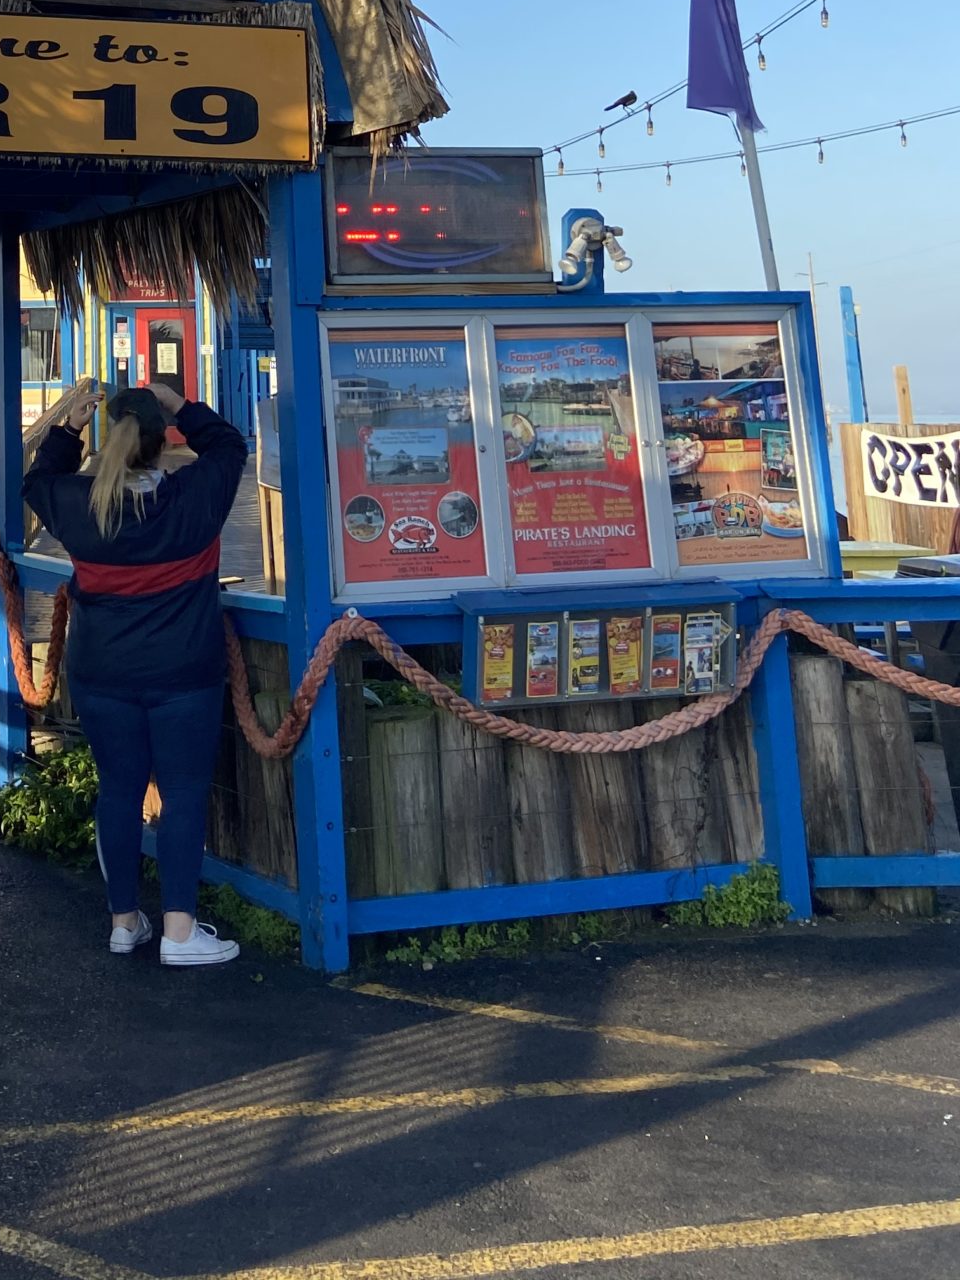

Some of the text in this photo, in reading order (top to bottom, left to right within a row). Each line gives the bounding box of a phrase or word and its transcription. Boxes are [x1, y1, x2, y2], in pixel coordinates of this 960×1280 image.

[93, 34, 190, 67] to:
[72, 83, 260, 145] 19
[354, 346, 446, 364] WATERFRONT
[508, 351, 552, 362] Famous
[514, 524, 636, 541] PIRATE'S LANDING
[547, 539, 605, 548] RESTAURANT
